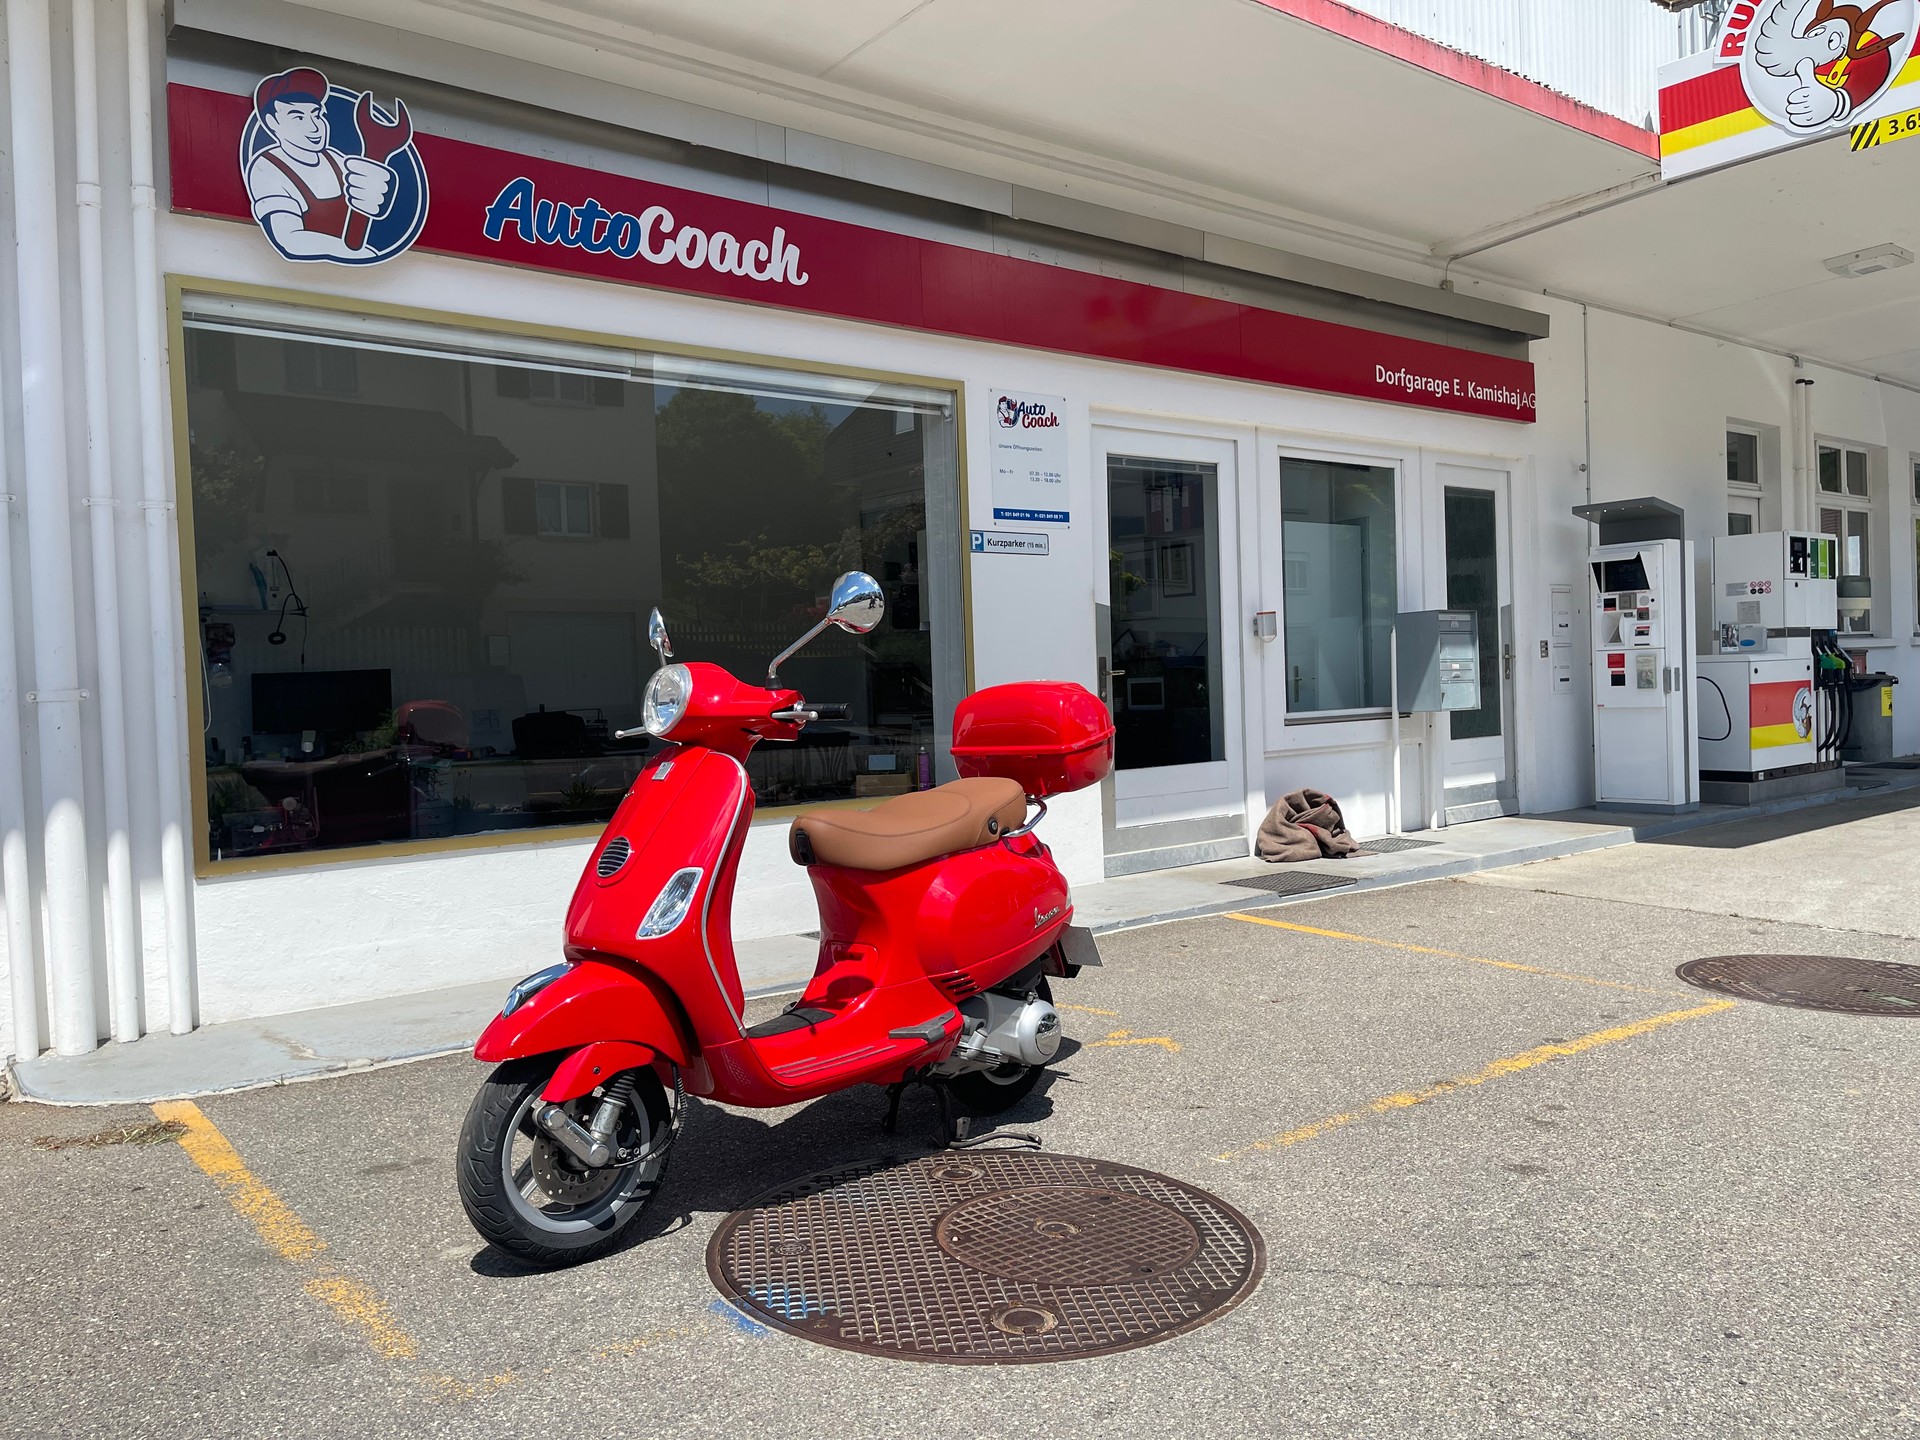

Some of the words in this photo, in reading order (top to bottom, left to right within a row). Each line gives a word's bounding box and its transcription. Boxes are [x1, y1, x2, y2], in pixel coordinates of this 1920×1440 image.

[1889, 112, 1920, 136] 3.6
[1375, 364, 1450, 398] Dorfgarage
[1453, 378, 1465, 397] E.
[1017, 401, 1046, 418] Auto
[1022, 412, 1060, 429] Coach
[971, 532, 983, 550] P
[987, 537, 1026, 549] Kurzparker
[1035, 542, 1047, 550] min.)
[1798, 557, 1804, 571] 1
